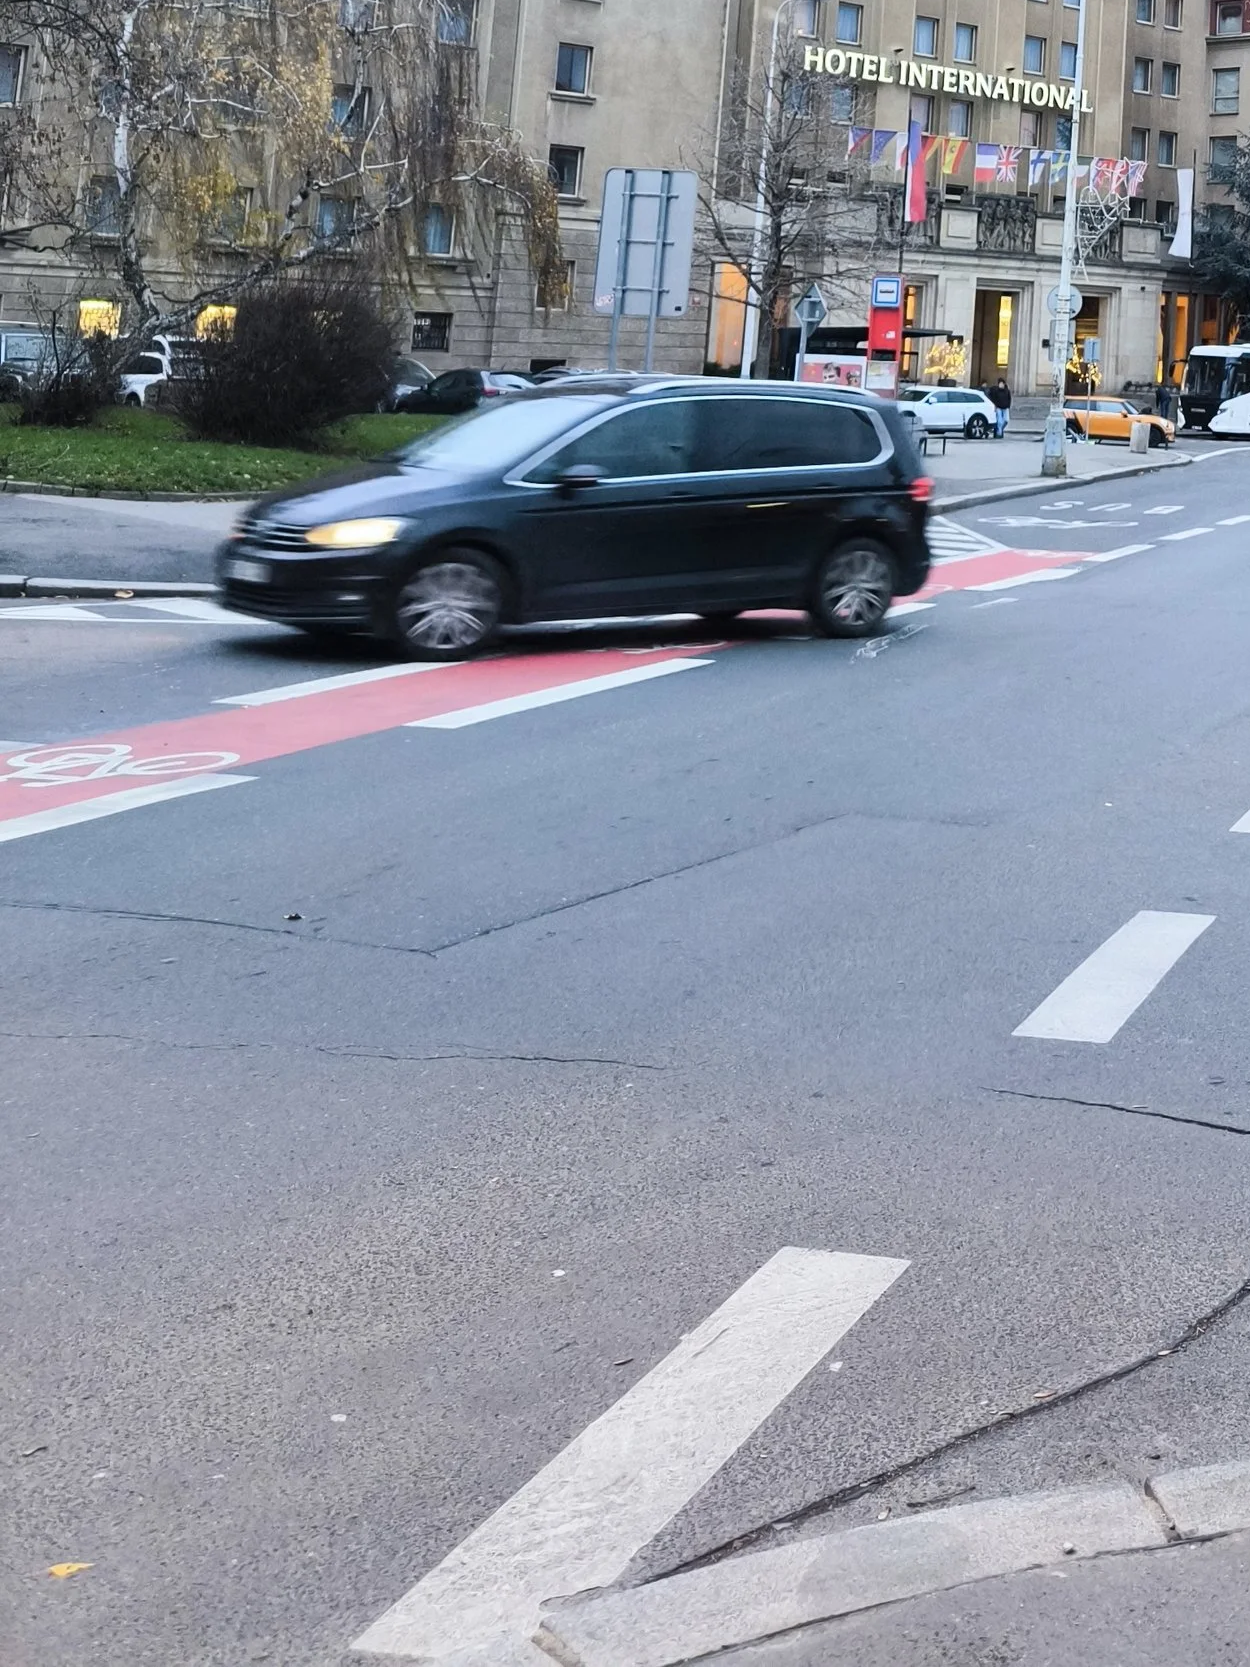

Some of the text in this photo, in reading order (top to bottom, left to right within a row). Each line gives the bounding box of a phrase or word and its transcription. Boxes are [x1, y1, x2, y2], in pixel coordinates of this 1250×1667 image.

[803, 45, 1094, 113] HOTEL INTERNATIONAL
[1040, 500, 1185, 515] BUS
